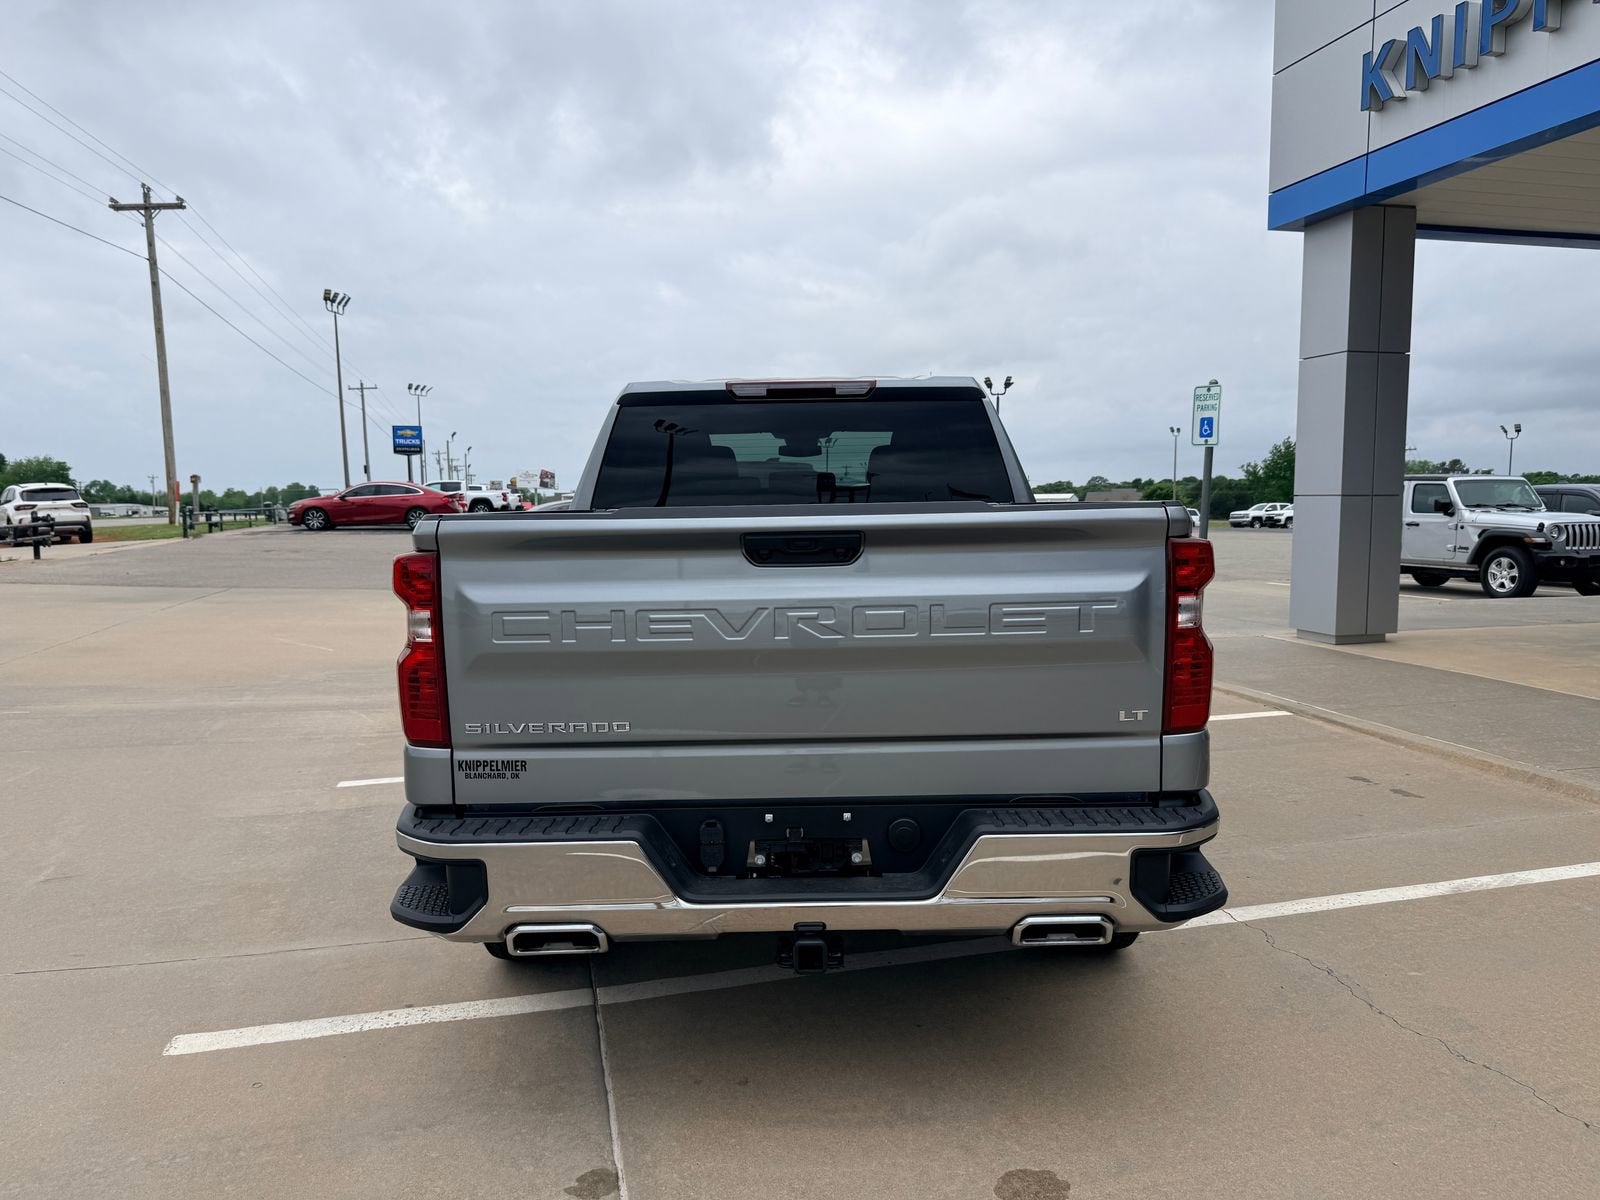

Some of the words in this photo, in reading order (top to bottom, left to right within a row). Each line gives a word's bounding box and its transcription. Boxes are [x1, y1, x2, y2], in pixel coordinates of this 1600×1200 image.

[1195, 392, 1220, 402] RESERVED
[1196, 403, 1218, 412] PARKING
[491, 601, 1122, 644] CHEVROLET
[1118, 709, 1149, 722] LT
[464, 721, 632, 735] SILVERADO
[457, 759, 528, 772] KNIPPELMIER
[464, 772, 509, 780] BLANCHARD,
[510, 772, 521, 780] OK
